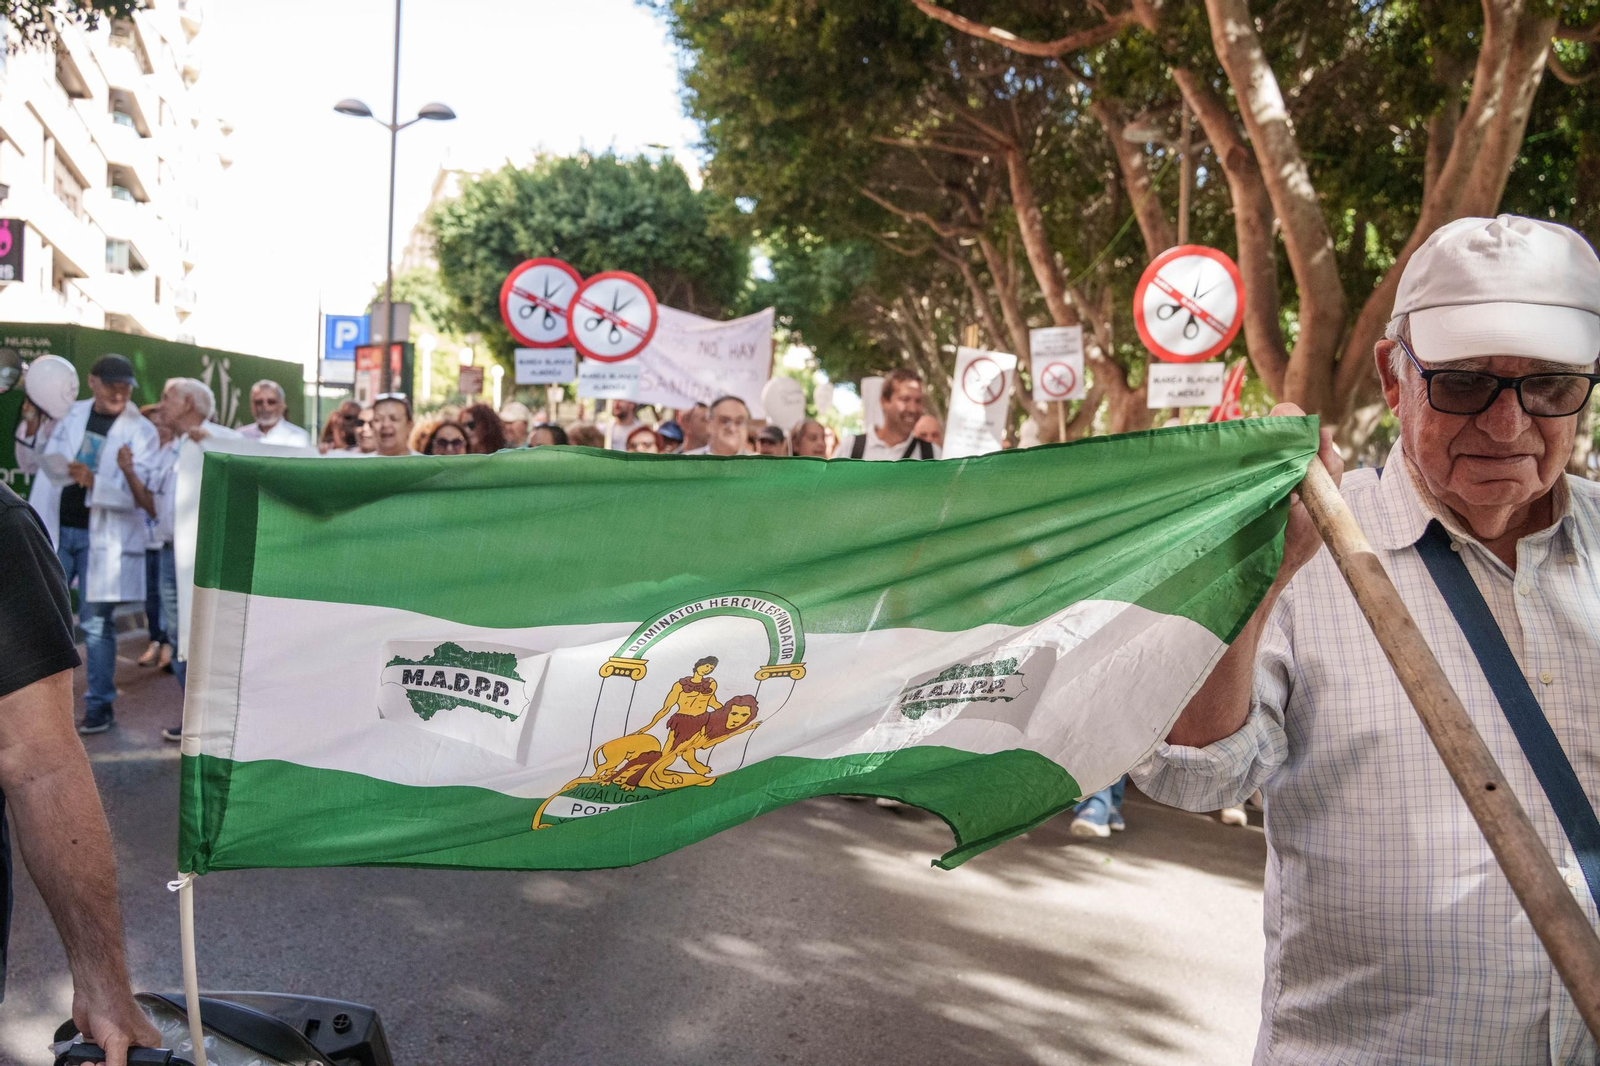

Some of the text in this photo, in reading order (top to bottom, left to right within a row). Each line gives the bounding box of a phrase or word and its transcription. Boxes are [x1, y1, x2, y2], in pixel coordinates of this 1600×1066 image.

[334, 321, 359, 349] P
[629, 602, 704, 652] DOMINATOR
[710, 597, 781, 616] HERCVLES
[402, 669, 510, 705] M.A.D.P.P.
[569, 787, 650, 803] ANDALUCIA
